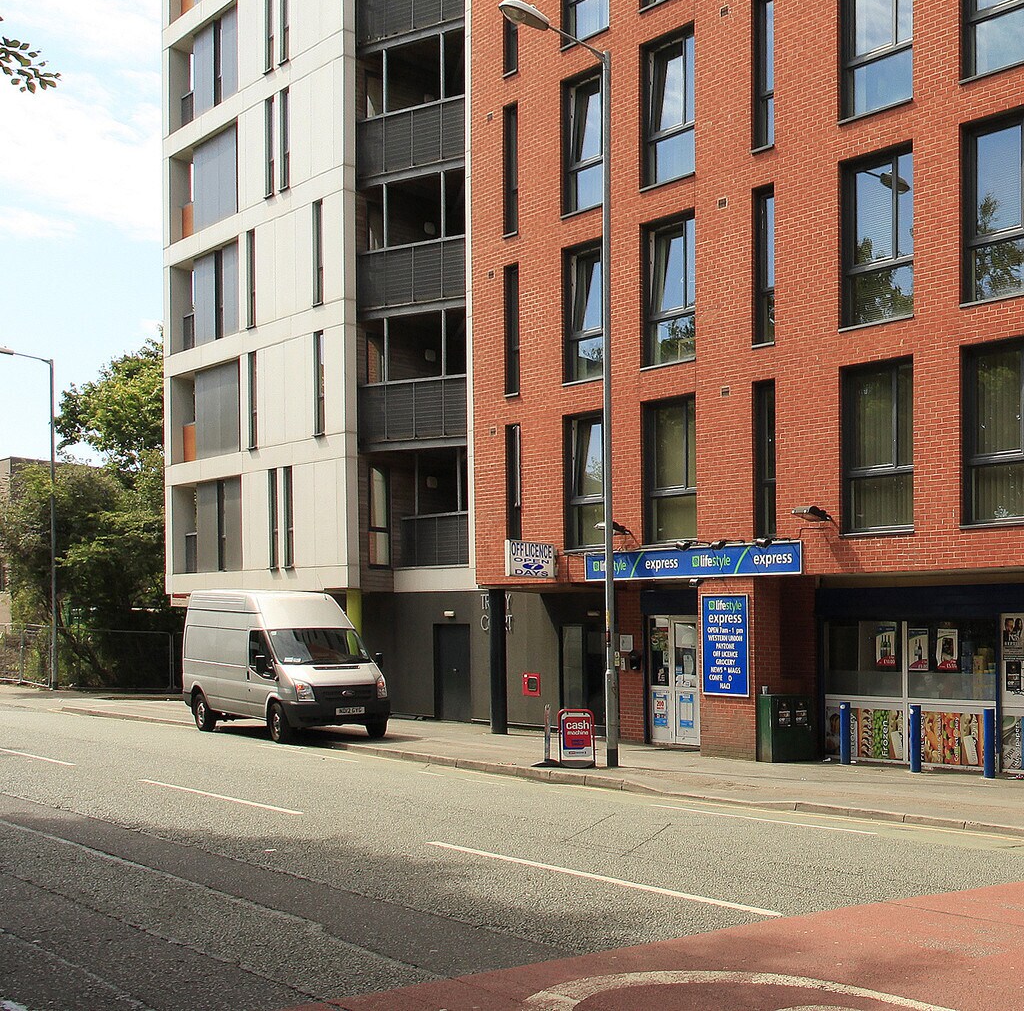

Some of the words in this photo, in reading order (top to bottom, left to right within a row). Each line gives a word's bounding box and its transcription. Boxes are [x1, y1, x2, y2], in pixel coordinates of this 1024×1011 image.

[514, 557, 550, 565] OPEN
[645, 558, 679, 572] express
[700, 554, 731, 570] lifestyle
[753, 552, 793, 567] express
[515, 569, 549, 577] DAYS
[715, 600, 742, 613] lifestyle
[708, 614, 742, 626] express
[565, 719, 590, 730] cash
